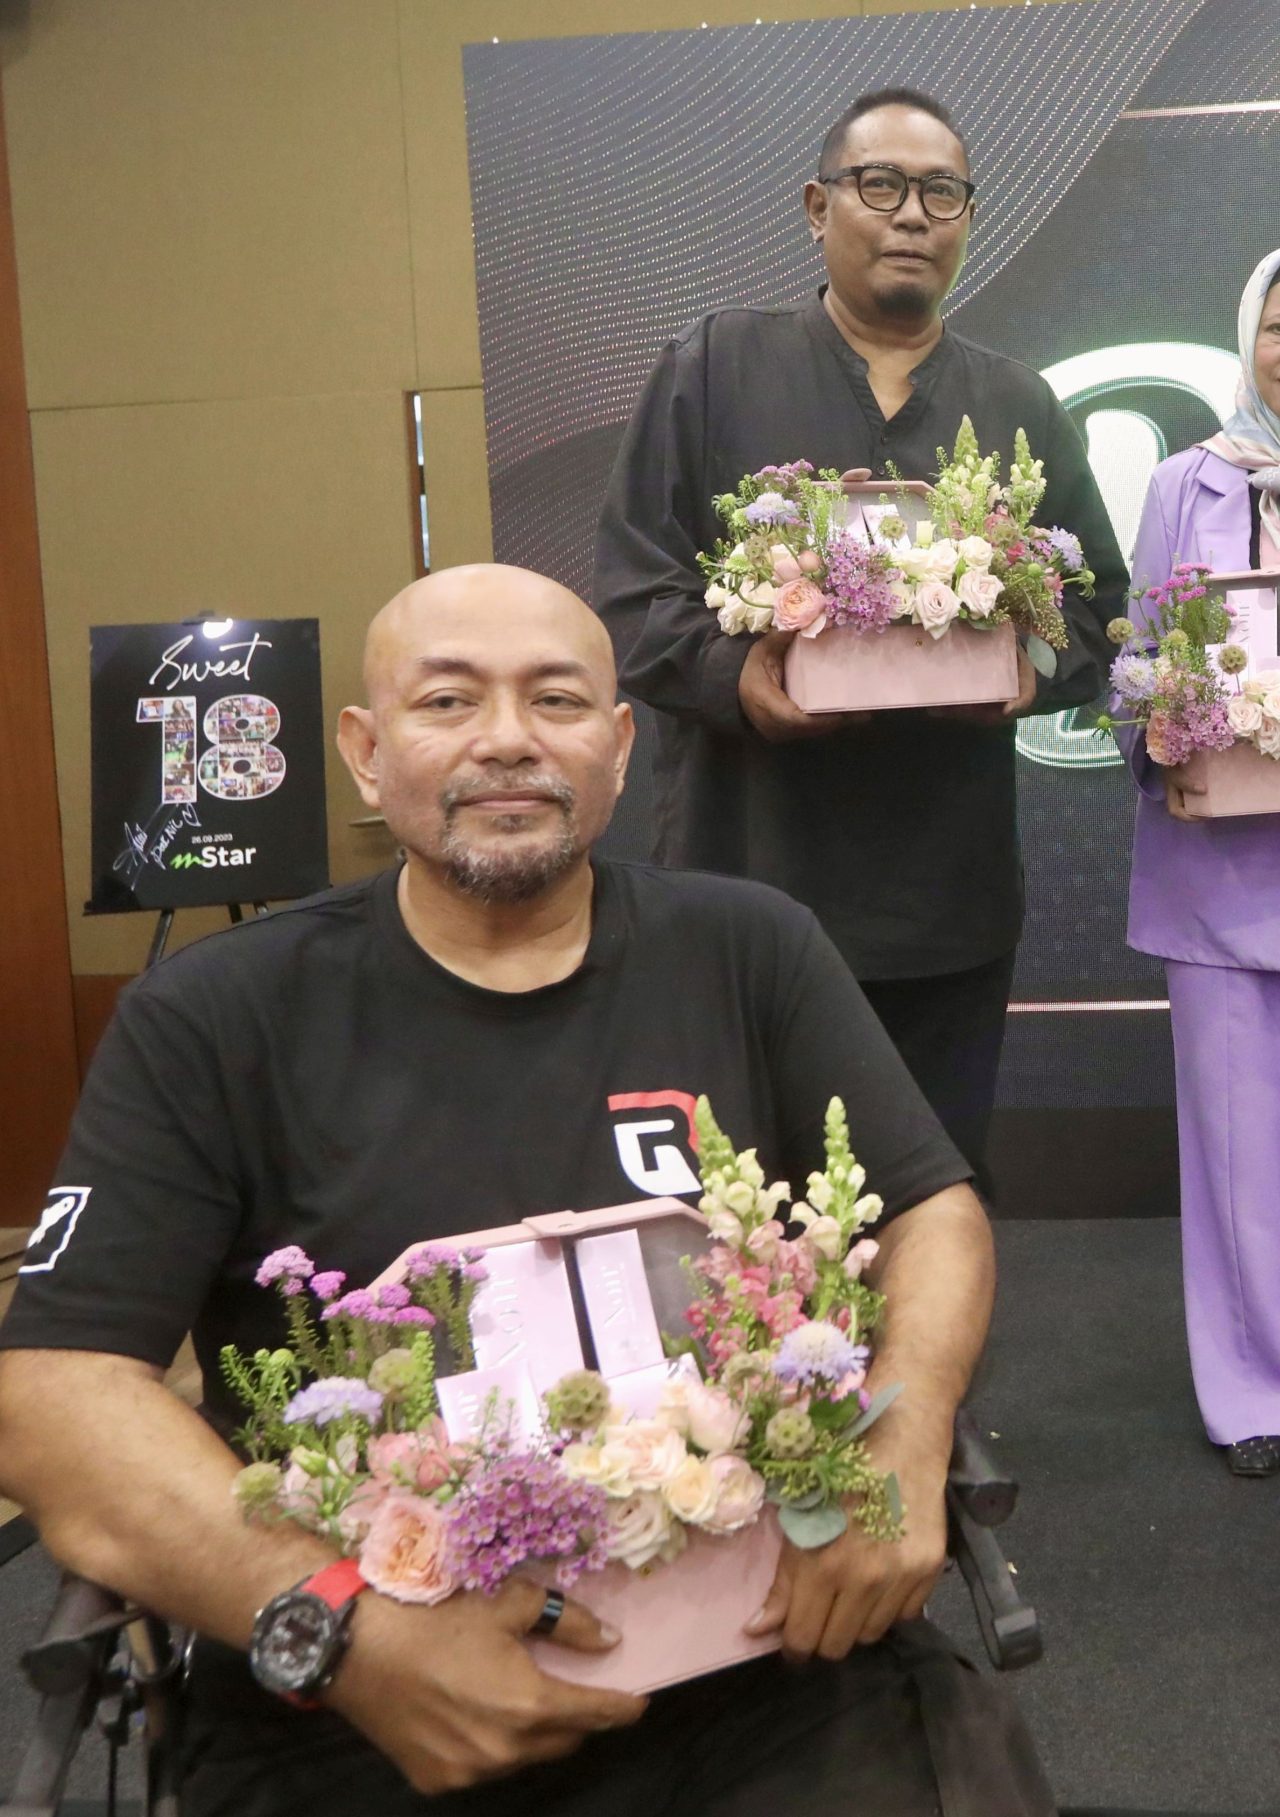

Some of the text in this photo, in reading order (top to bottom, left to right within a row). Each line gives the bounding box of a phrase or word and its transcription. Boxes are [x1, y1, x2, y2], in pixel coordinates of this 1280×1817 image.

[149, 633, 272, 690] Sweet
[136, 694, 286, 804] 18
[170, 846, 257, 869] mStar
